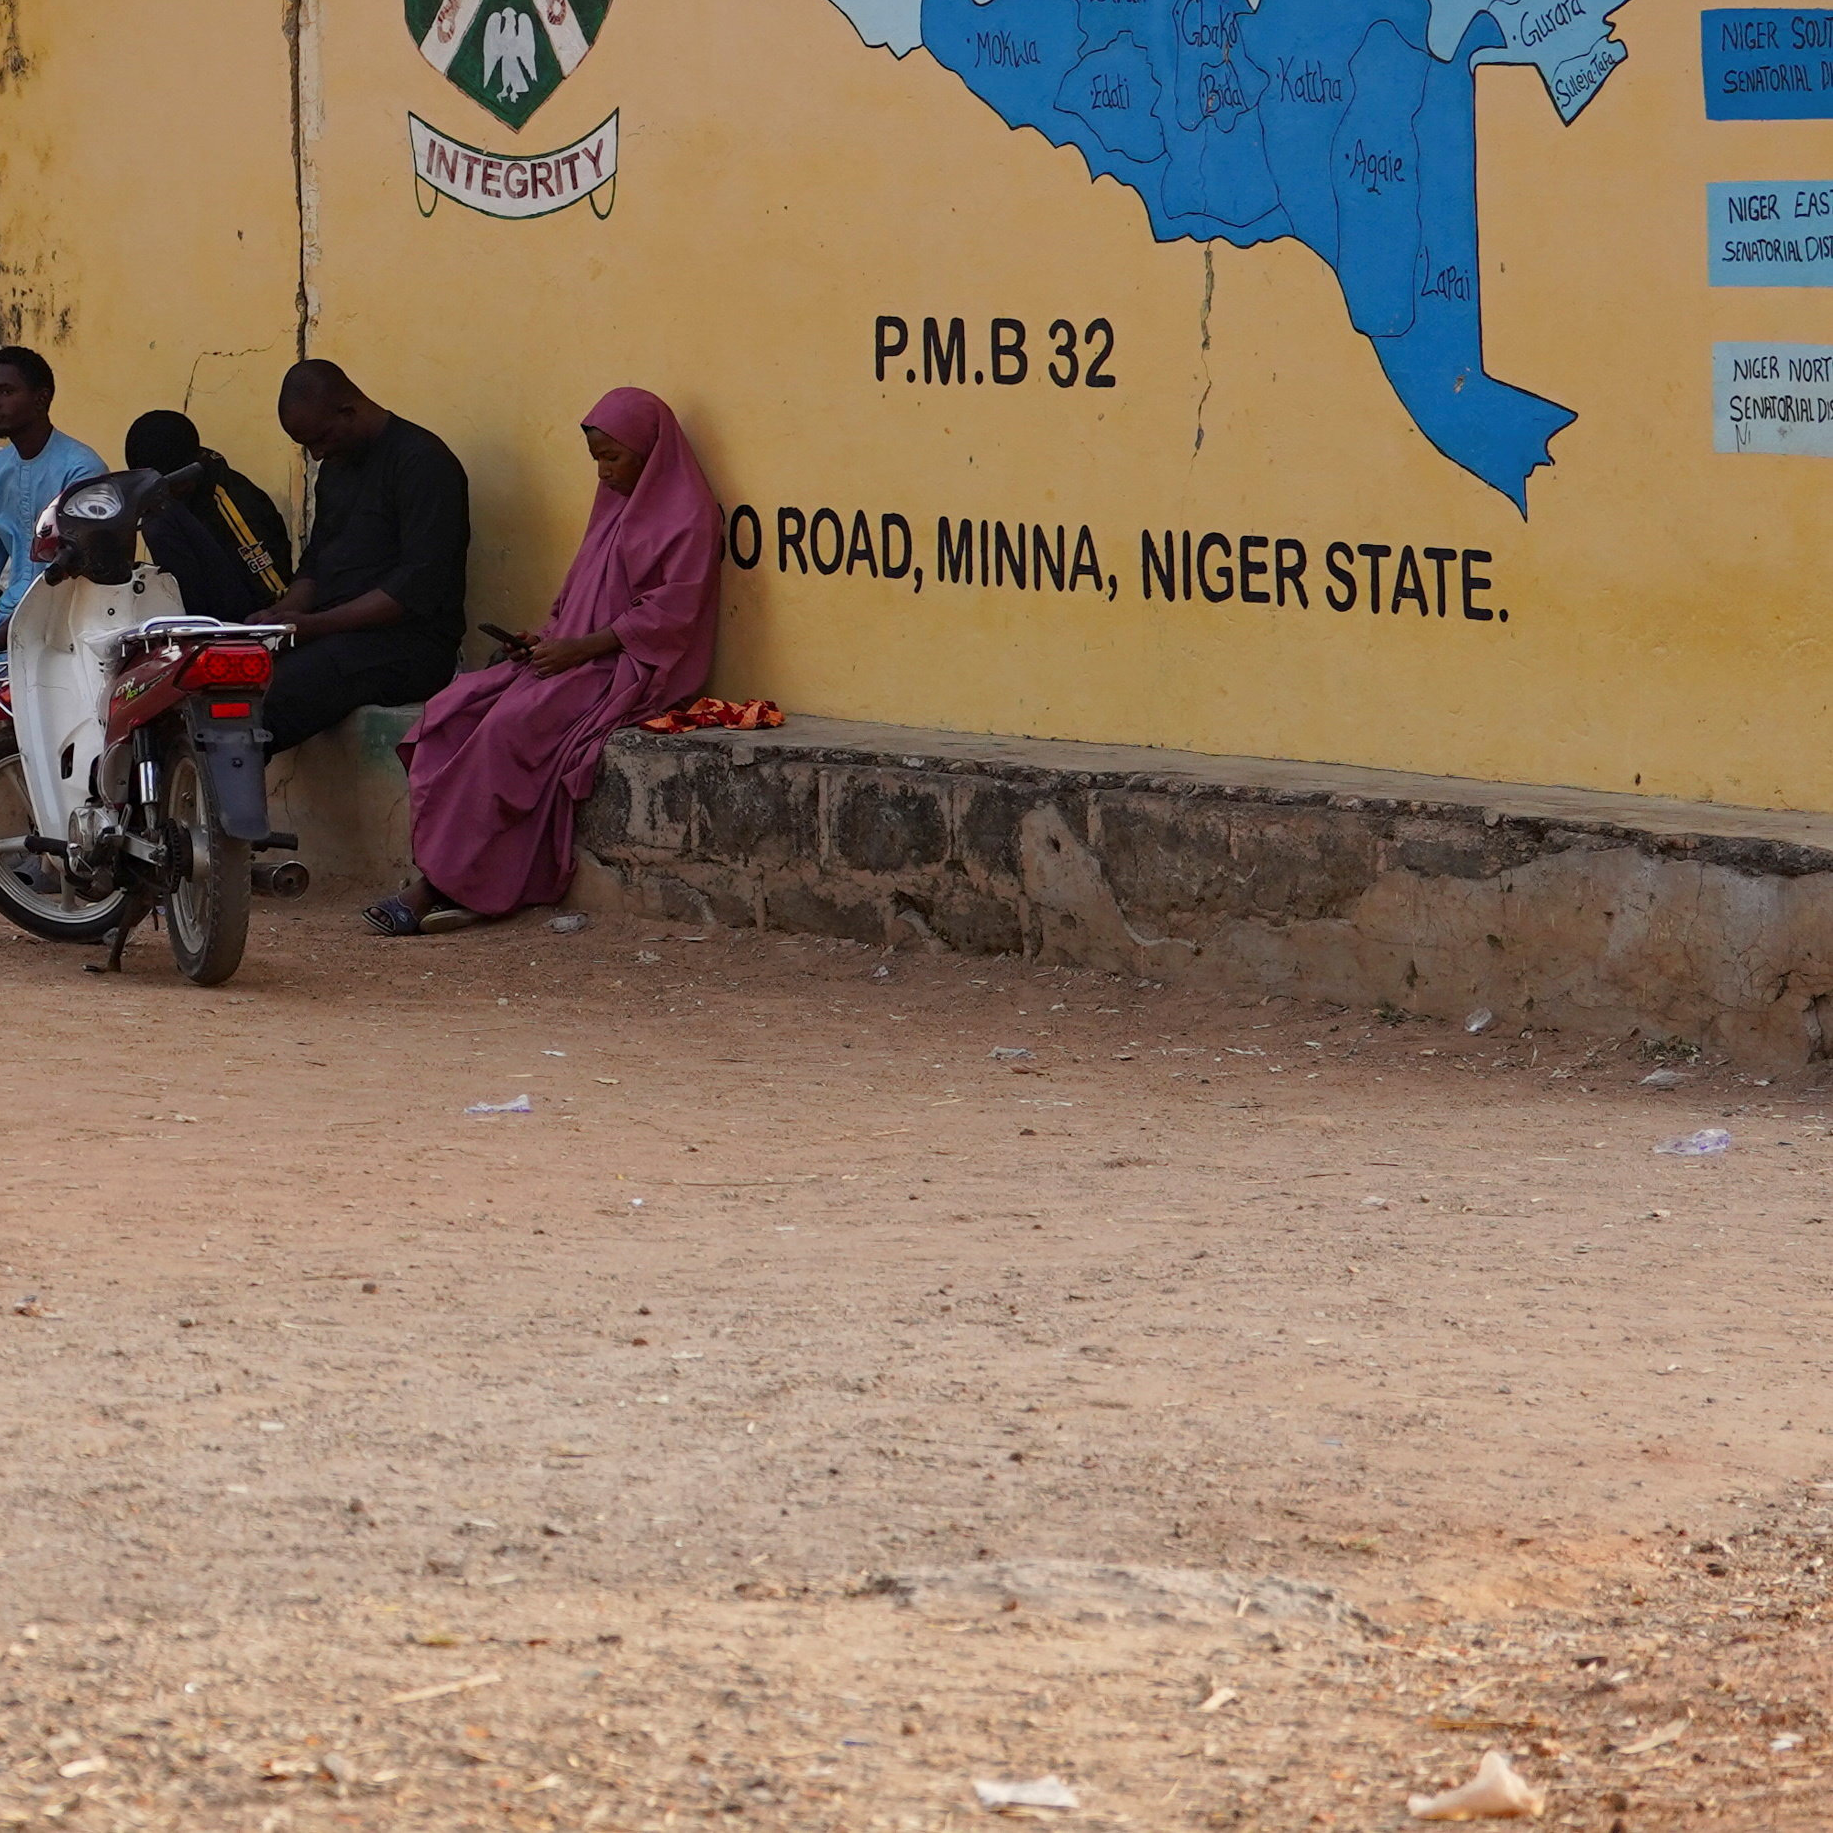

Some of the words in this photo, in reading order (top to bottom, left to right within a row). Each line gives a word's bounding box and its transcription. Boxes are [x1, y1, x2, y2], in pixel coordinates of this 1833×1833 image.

[1722, 21, 1779, 51] NIGER
[1091, 73, 1131, 110] Edati
[1203, 72, 1242, 114] Bida
[1278, 55, 1343, 104] Katcha
[1723, 64, 1812, 94] SENATORIAL
[426, 138, 605, 201] INTEGRITY
[1349, 136, 1405, 195] Agaie
[1729, 194, 1780, 224] NIGER
[1722, 239, 1803, 262] SENATORIAL
[876, 315, 1028, 387] P.M.B
[1048, 317, 1118, 390] 32
[1733, 356, 1780, 382] NIGER
[1730, 395, 1815, 422] SENATORIAL
[777, 507, 923, 594] ROAD,
[937, 517, 1118, 603] MINNA,
[1141, 529, 1309, 610] NIGER
[1325, 540, 1510, 624] STATE.
